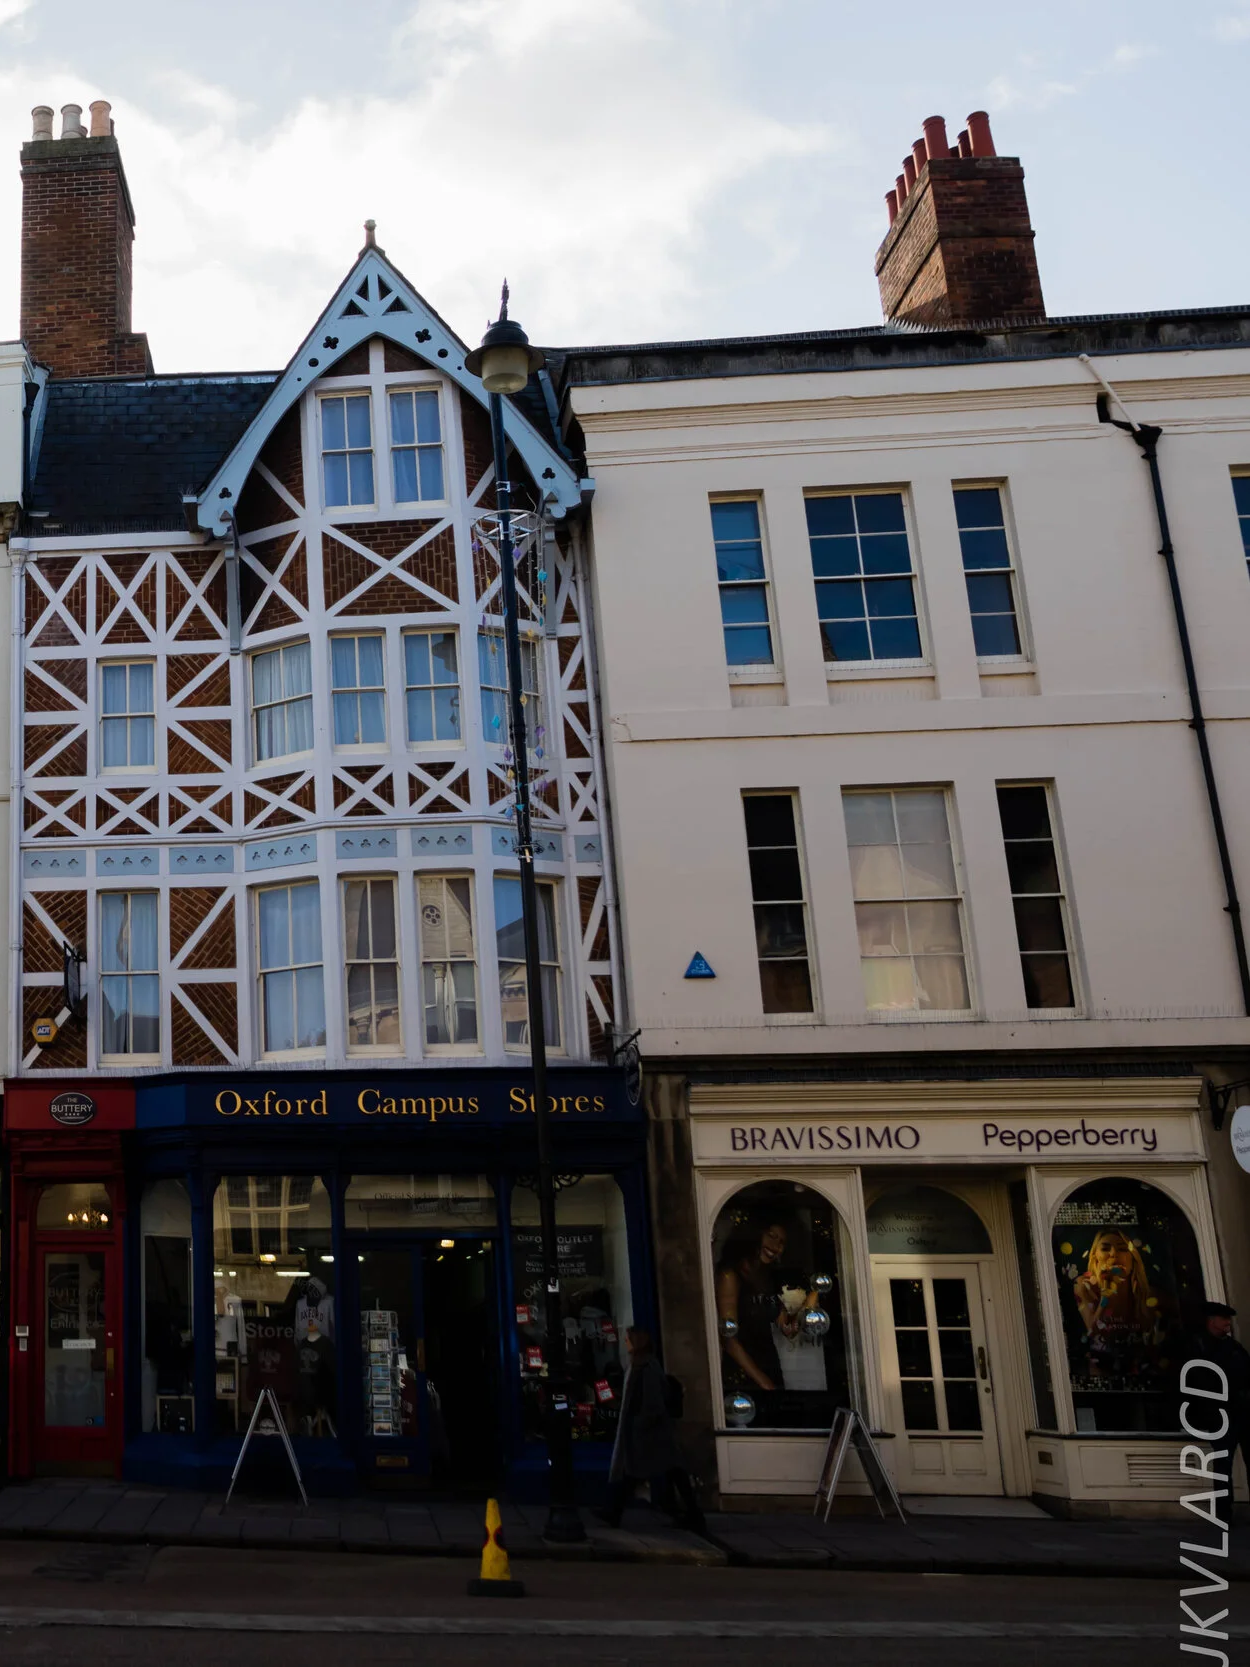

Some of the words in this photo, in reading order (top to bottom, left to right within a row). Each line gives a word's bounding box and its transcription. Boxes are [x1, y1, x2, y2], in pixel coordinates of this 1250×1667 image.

[50, 1104, 93, 1113] BUTTERY
[214, 1089, 328, 1116] Oxford
[356, 1088, 480, 1122] Campus
[508, 1086, 607, 1114] Stores
[730, 1124, 921, 1151] BRAVISSIMO
[982, 1118, 1158, 1152] Pepperberry
[556, 1234, 594, 1244] OUTLET
